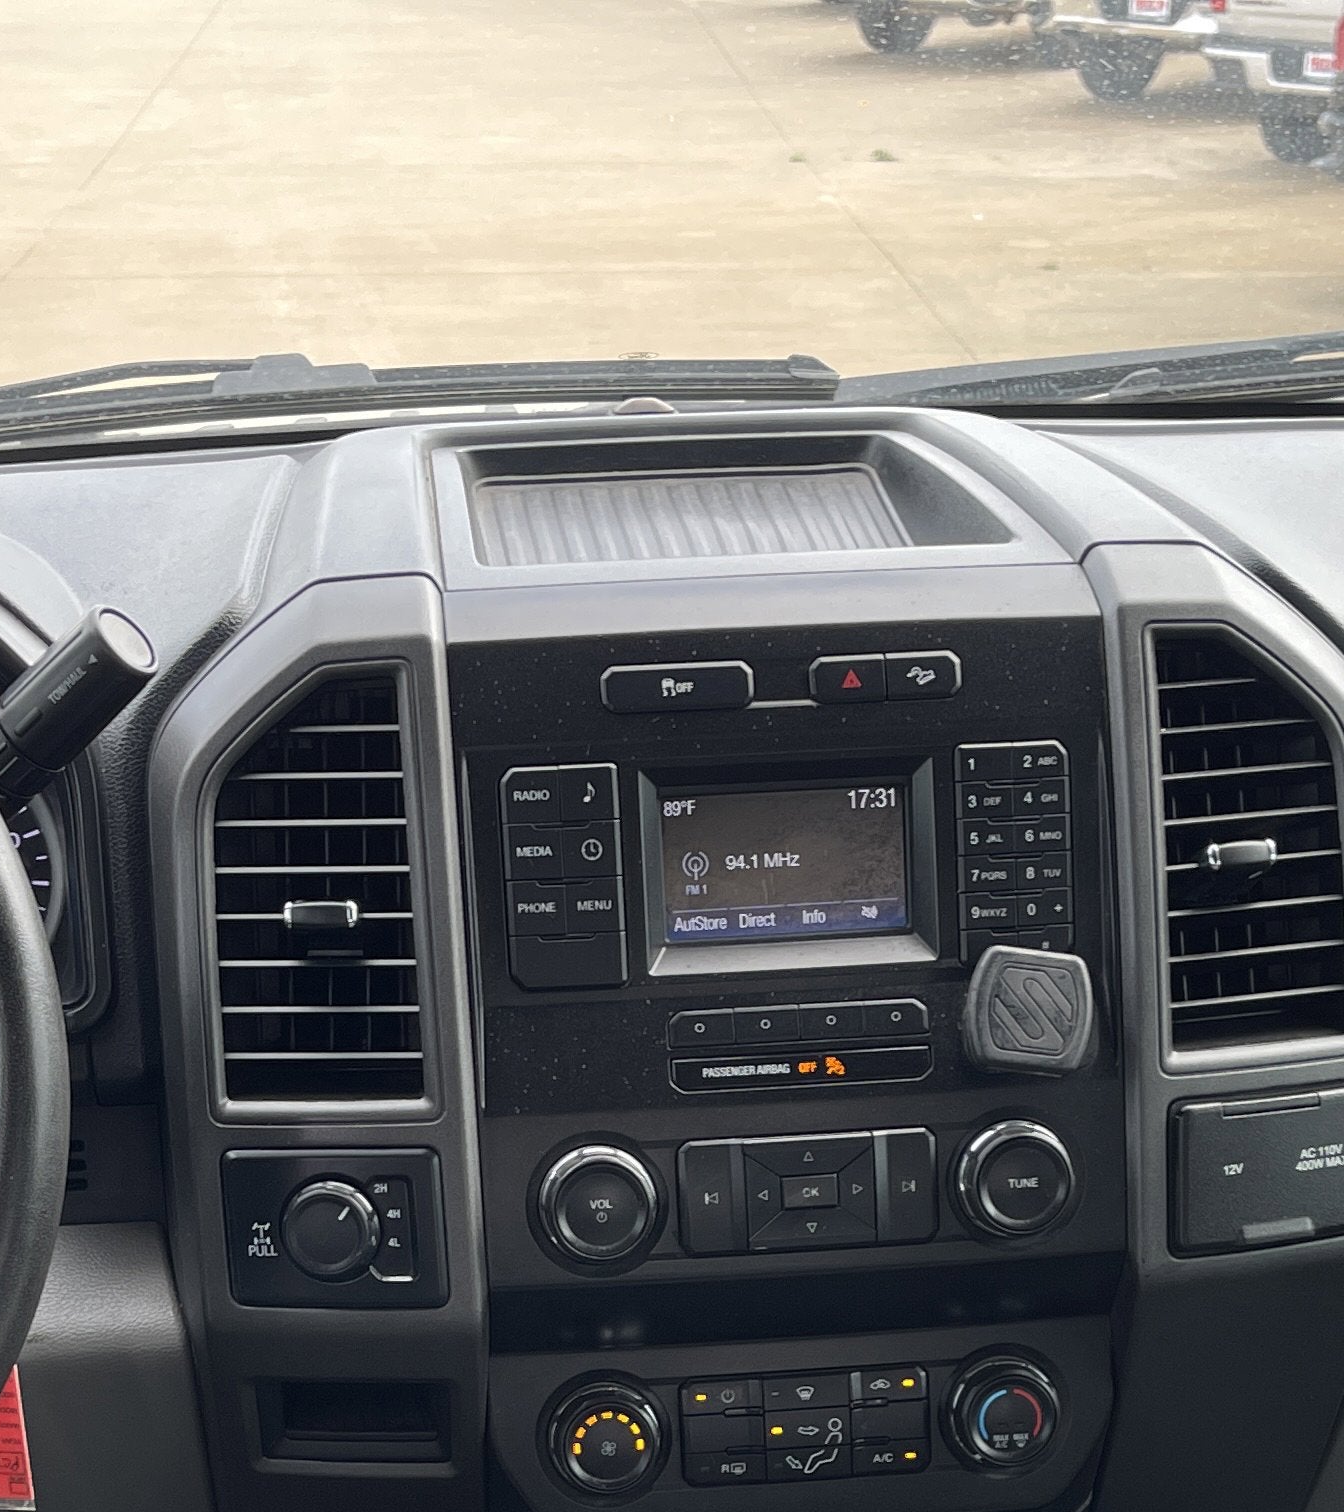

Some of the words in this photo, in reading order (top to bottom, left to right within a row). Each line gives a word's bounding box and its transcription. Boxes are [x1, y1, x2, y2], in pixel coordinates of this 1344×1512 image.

[675, 681, 694, 693] OFF
[968, 758, 976, 770] 1
[1023, 755, 1033, 768] 2
[1037, 756, 1058, 766] ABC
[513, 789, 550, 801] RADIO
[847, 787, 897, 809] 17:31
[1023, 792, 1033, 803] 4
[1040, 793, 1058, 802] GHI
[968, 795, 977, 808] 3
[983, 796, 1002, 806] DEF
[663, 800, 696, 817] 89°F
[969, 832, 979, 845] 5
[986, 834, 1003, 843] JKL
[1024, 830, 1034, 842] 6
[1039, 831, 1062, 840] MNO
[516, 846, 553, 857] MEDIA
[724, 854, 758, 870] 94.1
[764, 852, 801, 868] MHz
[970, 869, 980, 882] 7
[981, 871, 1007, 880] PQRS
[1025, 867, 1035, 880] 8
[1042, 868, 1061, 878] TUV
[685, 885, 700, 895] FM
[702, 884, 708, 894] 1
[517, 902, 557, 914] PHONE
[577, 900, 612, 911] MENU
[1026, 904, 1036, 916] 0
[802, 908, 827, 924] Info
[970, 906, 980, 918] 9
[980, 907, 1008, 917] WXYZ
[674, 915, 728, 932] AutStore
[739, 912, 777, 929] Direct
[702, 1065, 756, 1078] PASSENGER
[756, 1063, 791, 1075] AIRBAG
[798, 1062, 817, 1073] OFF
[1300, 1147, 1317, 1159] AC
[1318, 1143, 1344, 1157] 110V
[1223, 1163, 1244, 1176] 12V
[1295, 1158, 1325, 1172] 400W
[373, 1183, 388, 1194] 2H
[1008, 1177, 1039, 1189] TUNE
[802, 1187, 820, 1198] OK
[589, 1198, 613, 1210] VOL
[387, 1209, 401, 1219] 4H
[388, 1238, 401, 1248] 4L
[248, 1245, 278, 1257] PULL
[872, 1453, 894, 1463] A/C
